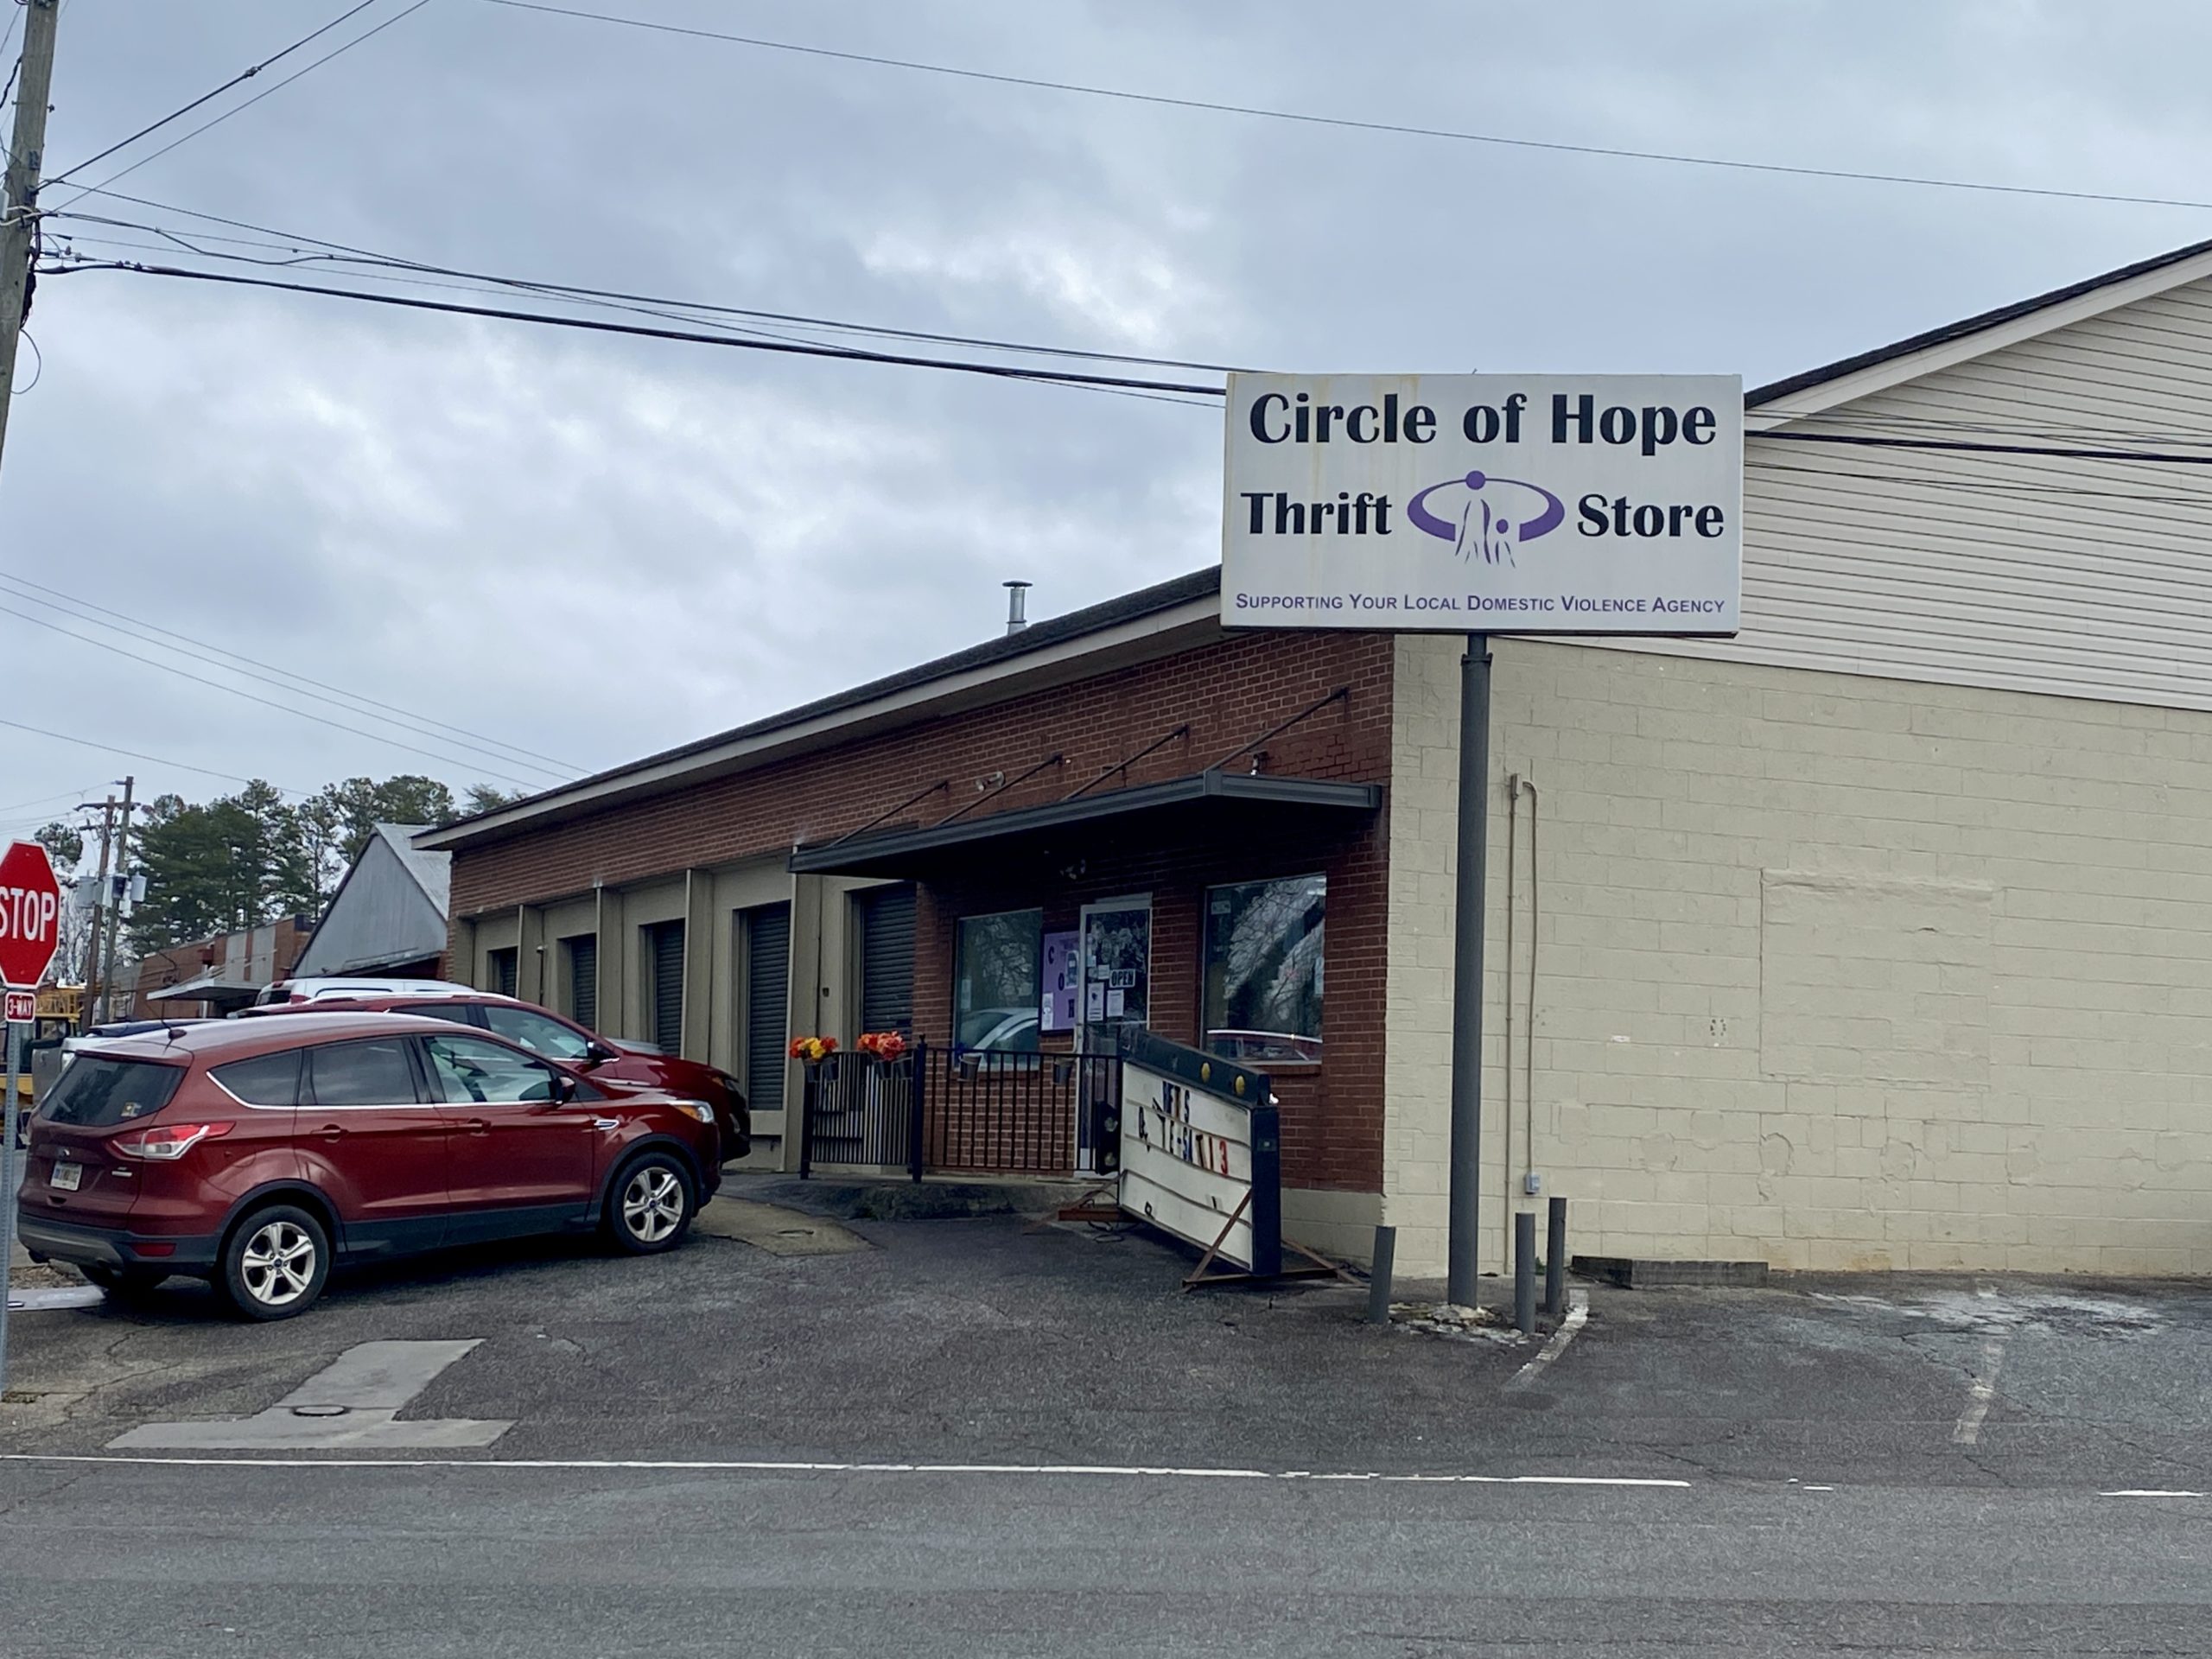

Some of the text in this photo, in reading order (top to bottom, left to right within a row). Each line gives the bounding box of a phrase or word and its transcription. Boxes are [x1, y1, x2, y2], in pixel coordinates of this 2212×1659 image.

[1249, 392, 1717, 457] Circle of Hope
[1240, 492, 1725, 538] Thrift Store
[0, 886, 56, 942] STOP
[1111, 970, 1135, 987] OPEN
[8, 997, 34, 1017] 3-WAY
